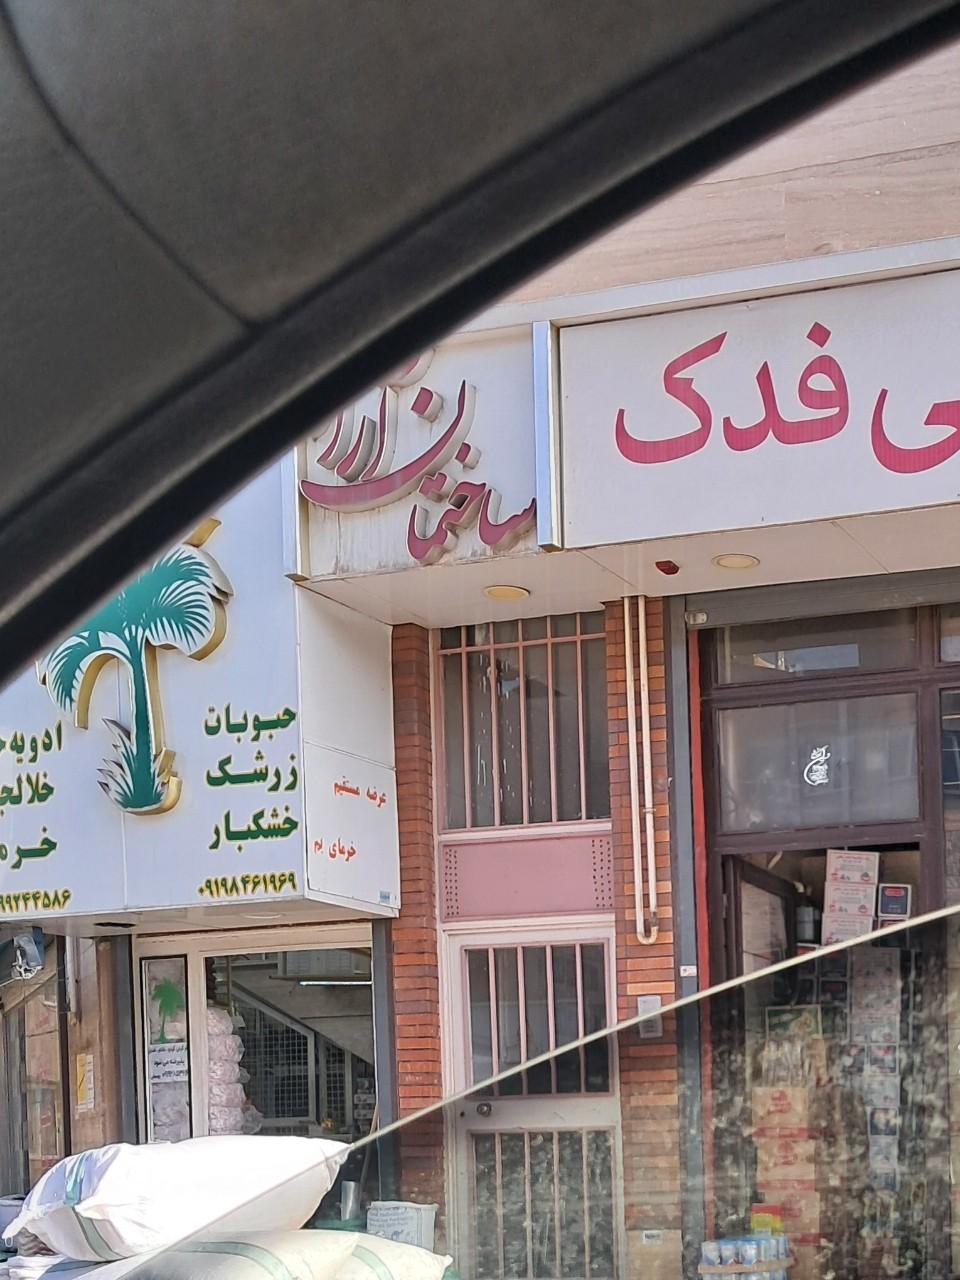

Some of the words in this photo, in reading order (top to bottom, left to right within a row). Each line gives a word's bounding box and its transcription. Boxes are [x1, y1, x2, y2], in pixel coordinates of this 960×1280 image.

[614, 321, 851, 465] فدک
[203, 702, 298, 744] حبوبات
[206, 749, 299, 792] زرشک
[208, 804, 299, 853] خشکبار
[328, 837, 357, 862] خرمای
